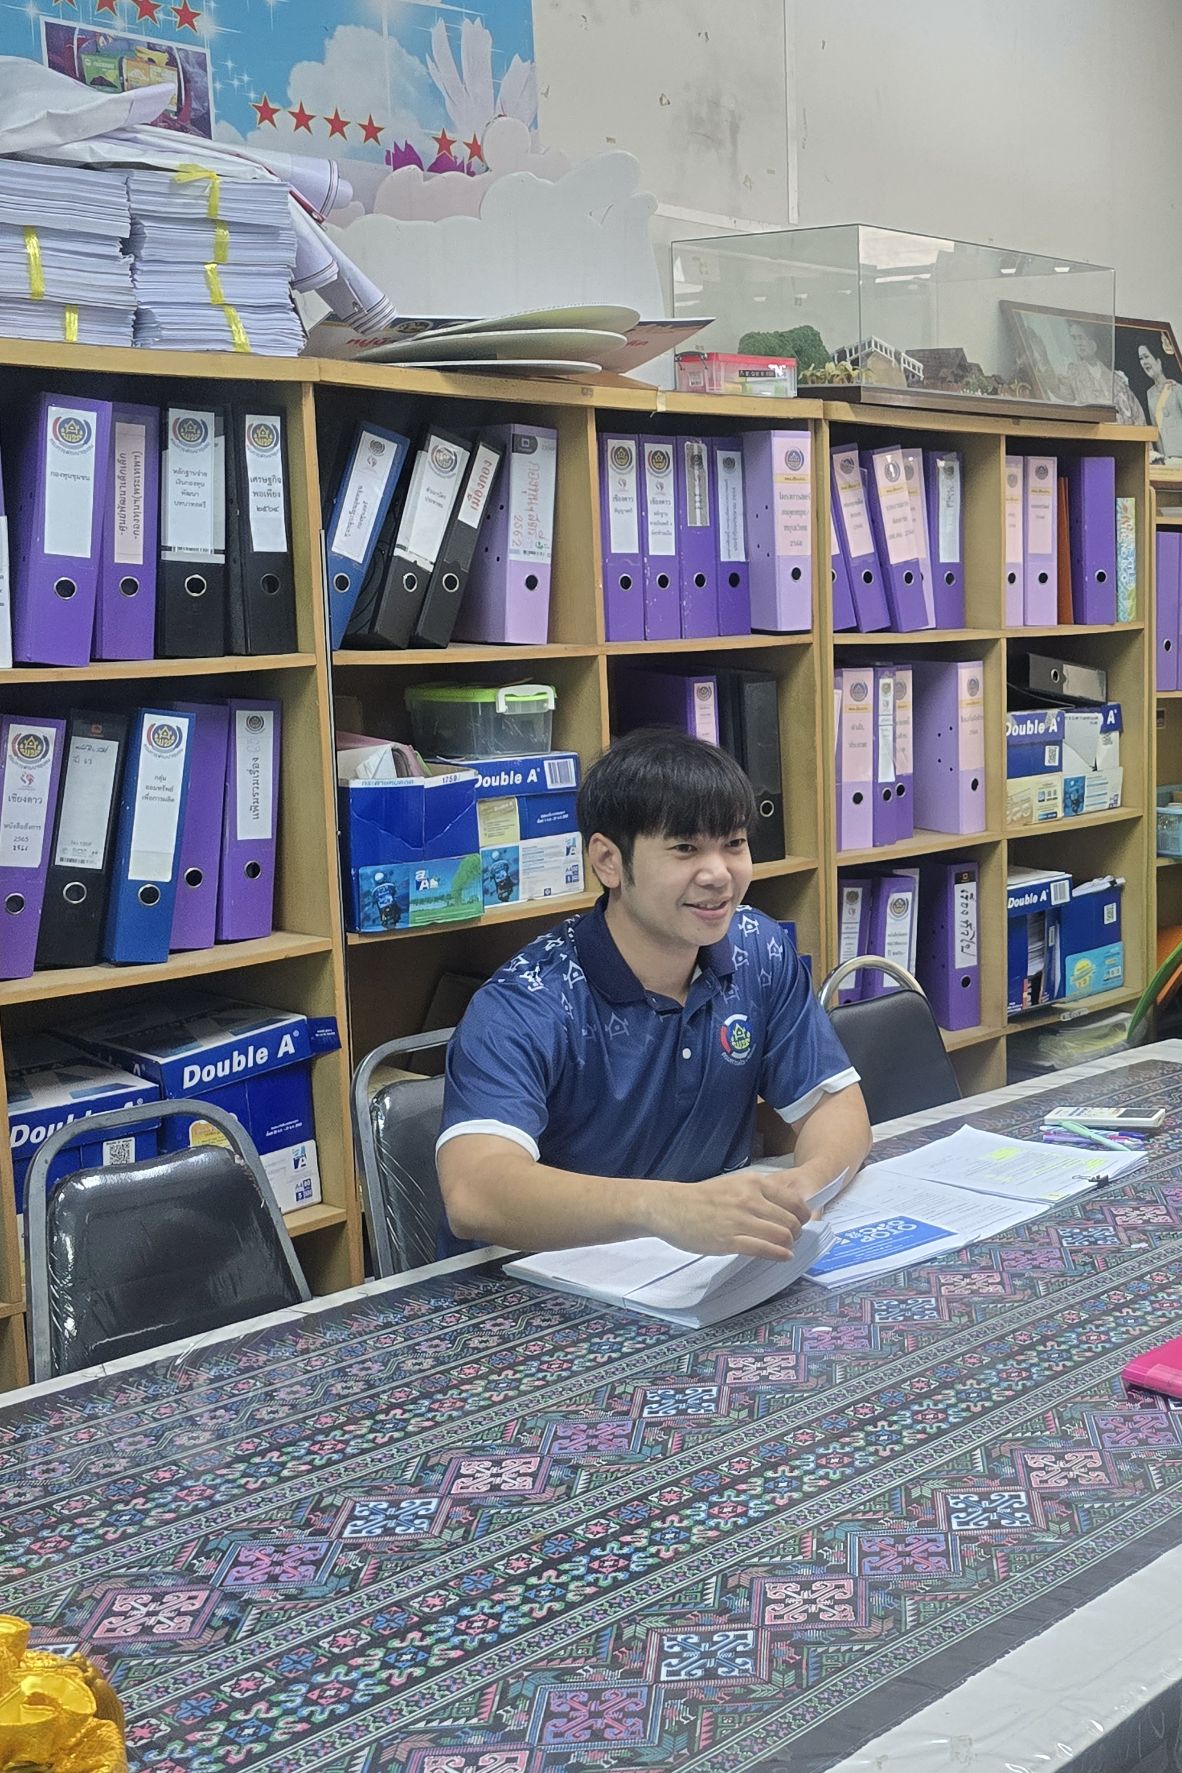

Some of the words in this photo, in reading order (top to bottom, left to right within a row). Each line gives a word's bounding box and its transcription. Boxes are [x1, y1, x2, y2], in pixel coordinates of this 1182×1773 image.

[249, 474, 282, 487] เศรษฐกิจ
[252, 488, 281, 498] พอเพียง
[511, 515, 524, 548] 2562
[1048, 718, 1058, 733] A
[526, 768, 538, 783] A
[248, 757, 261, 821] แฟ้มรวมเรื่อง
[8, 793, 43, 805] เชียงดาว
[1007, 893, 1038, 909] Double
[1039, 890, 1047, 902] A
[182, 1046, 269, 1090] Double
[277, 1034, 295, 1058] A
